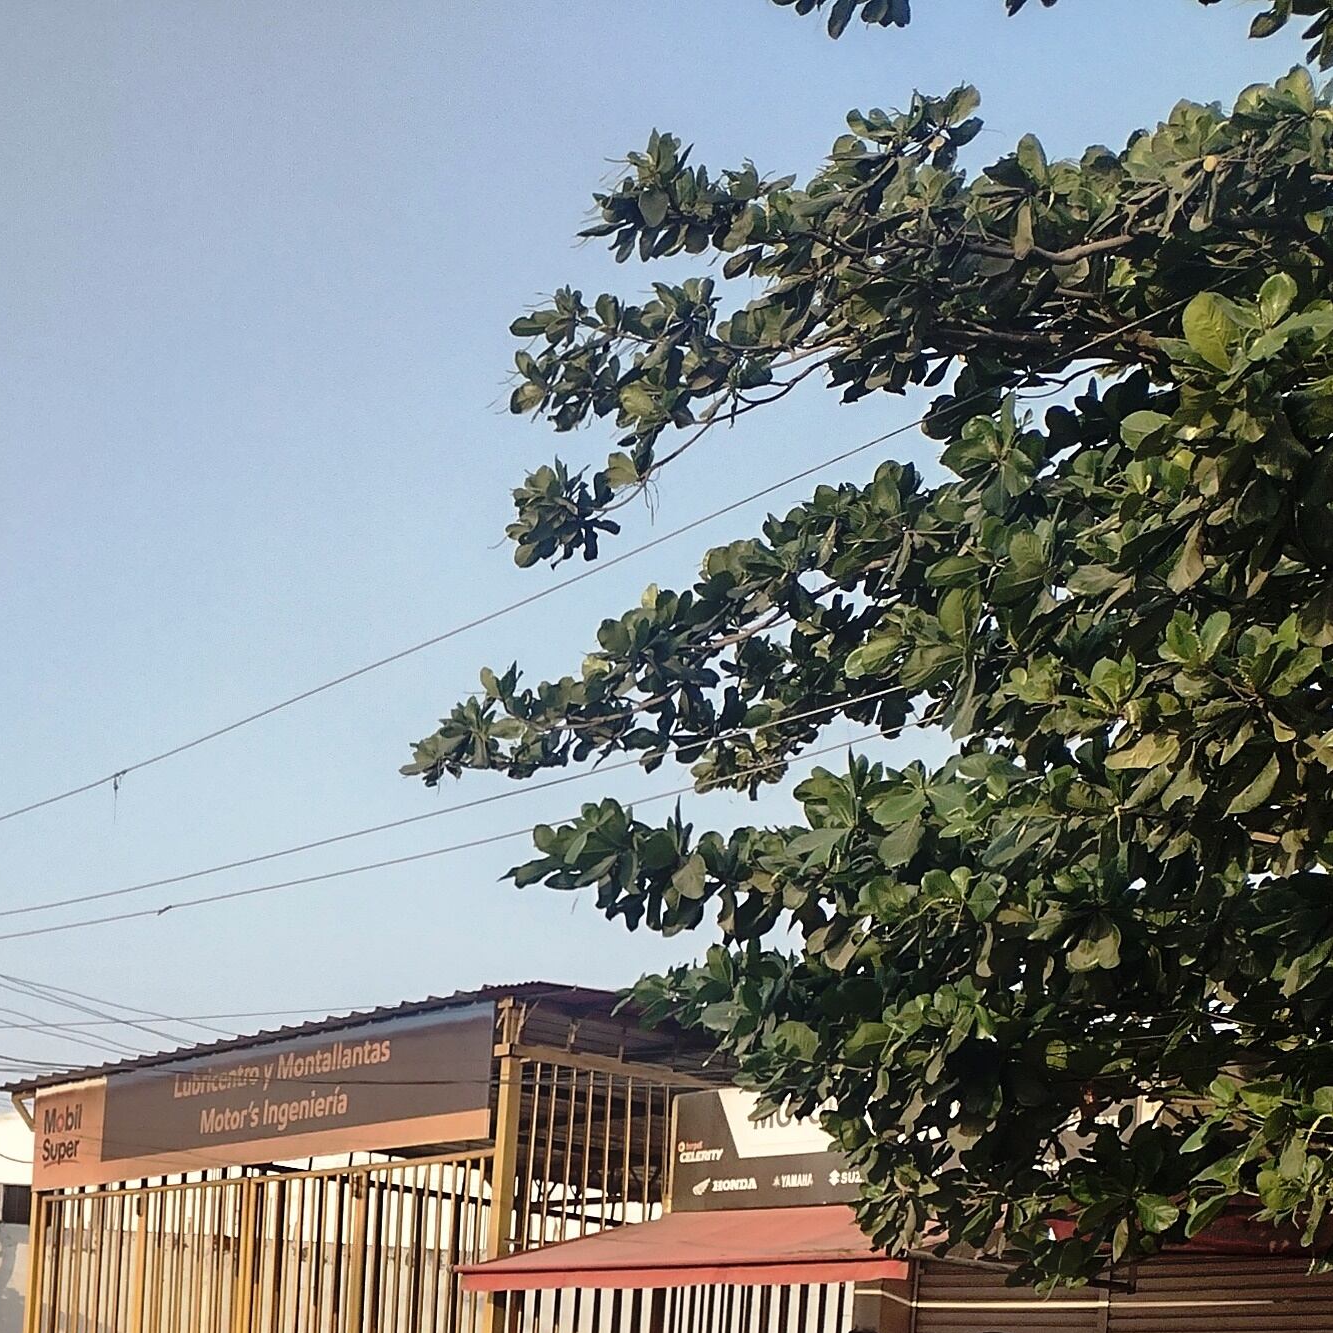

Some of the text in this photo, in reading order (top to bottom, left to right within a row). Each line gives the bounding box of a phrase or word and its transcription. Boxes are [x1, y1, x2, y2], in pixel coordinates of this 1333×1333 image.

[174, 1039, 391, 1099] Lubricentro y Montallantas
[44, 1106, 82, 1135] Mobil
[200, 1086, 349, 1135] Motor's Ingeniería
[42, 1138, 79, 1163] Super
[679, 1148, 724, 1163] CELERITY
[712, 1178, 757, 1192] HONDA
[781, 1173, 813, 1188] YAMAHA
